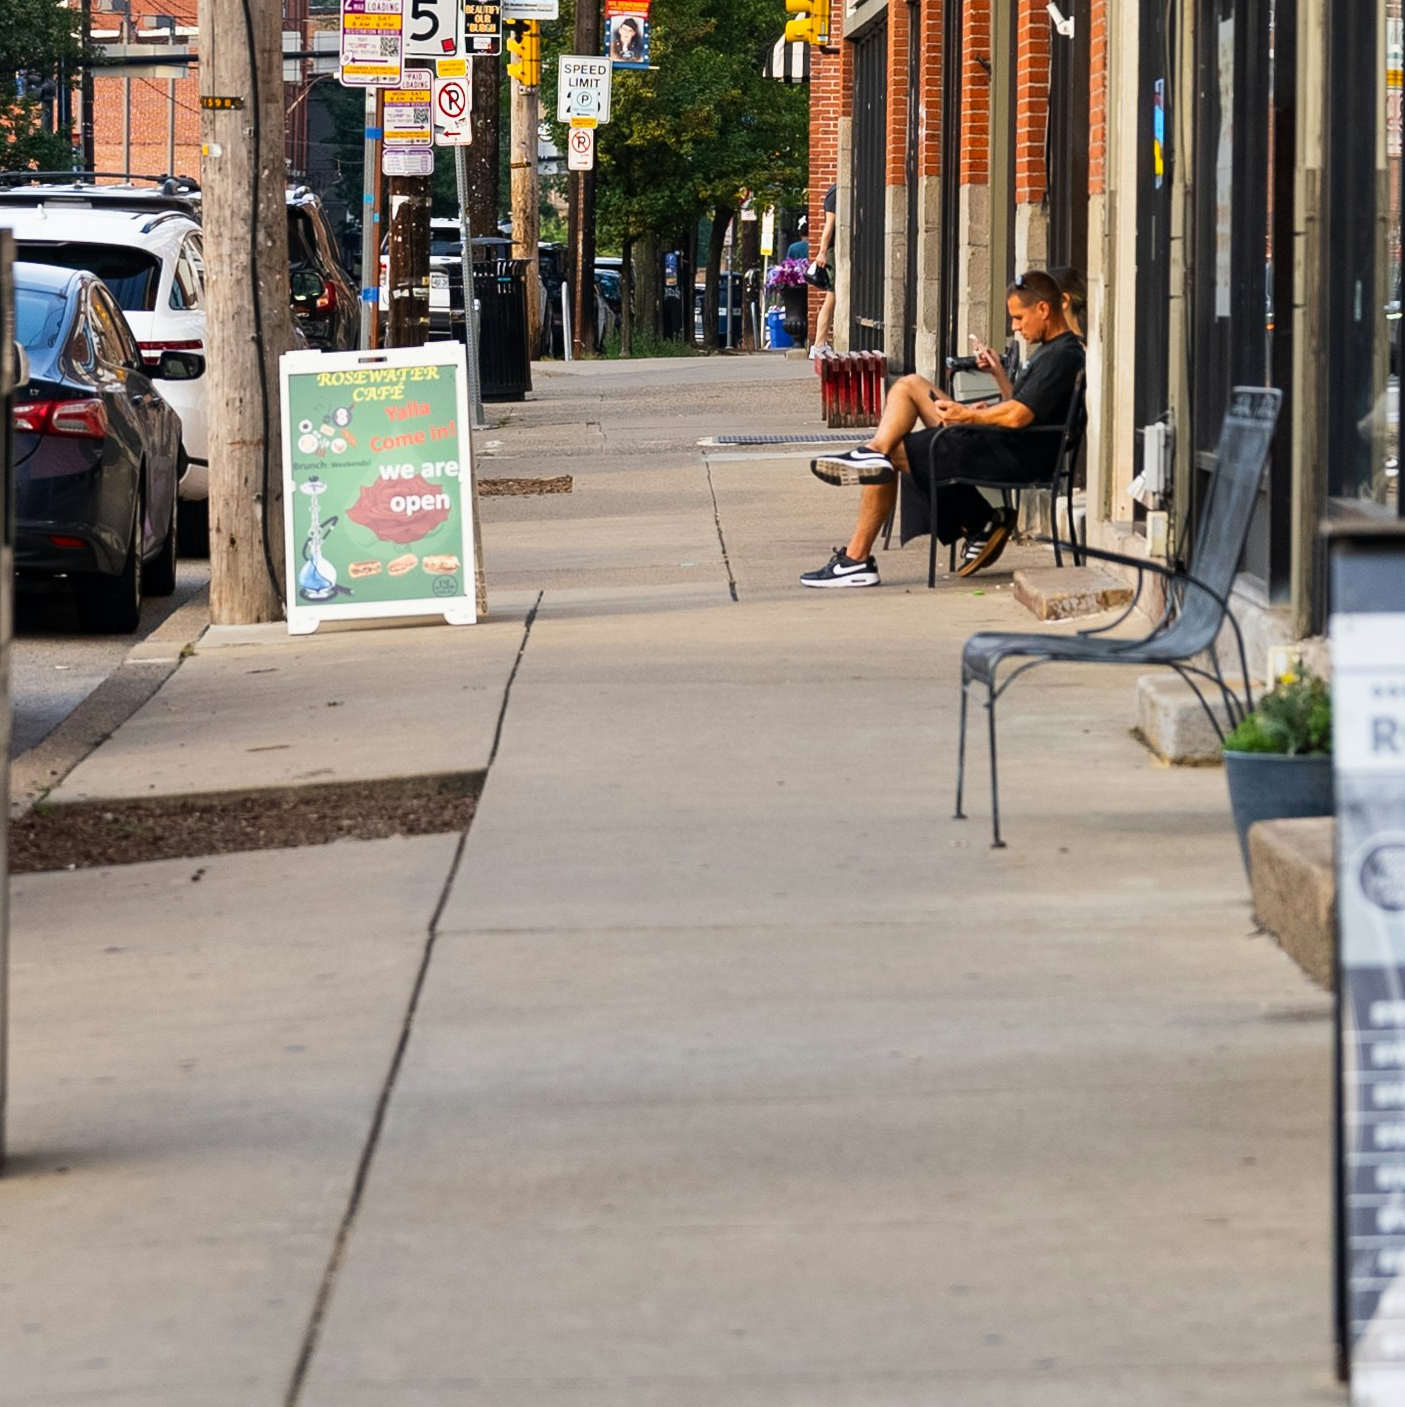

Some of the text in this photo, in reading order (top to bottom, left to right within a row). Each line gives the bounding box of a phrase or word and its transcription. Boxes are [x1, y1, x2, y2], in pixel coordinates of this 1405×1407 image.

[367, 3, 400, 12] LOADING
[465, 5, 500, 14] BEAUTIFY
[564, 64, 606, 75] SPEED
[403, 80, 428, 89] LOADING
[568, 78, 601, 88] LIMIT
[317, 365, 440, 387] ROSEWATER
[352, 382, 405, 402] CAFÉ
[385, 401, 430, 422] Yalla
[369, 421, 457, 452] Come in!
[379, 460, 459, 480] we are
[390, 493, 451, 516] open
